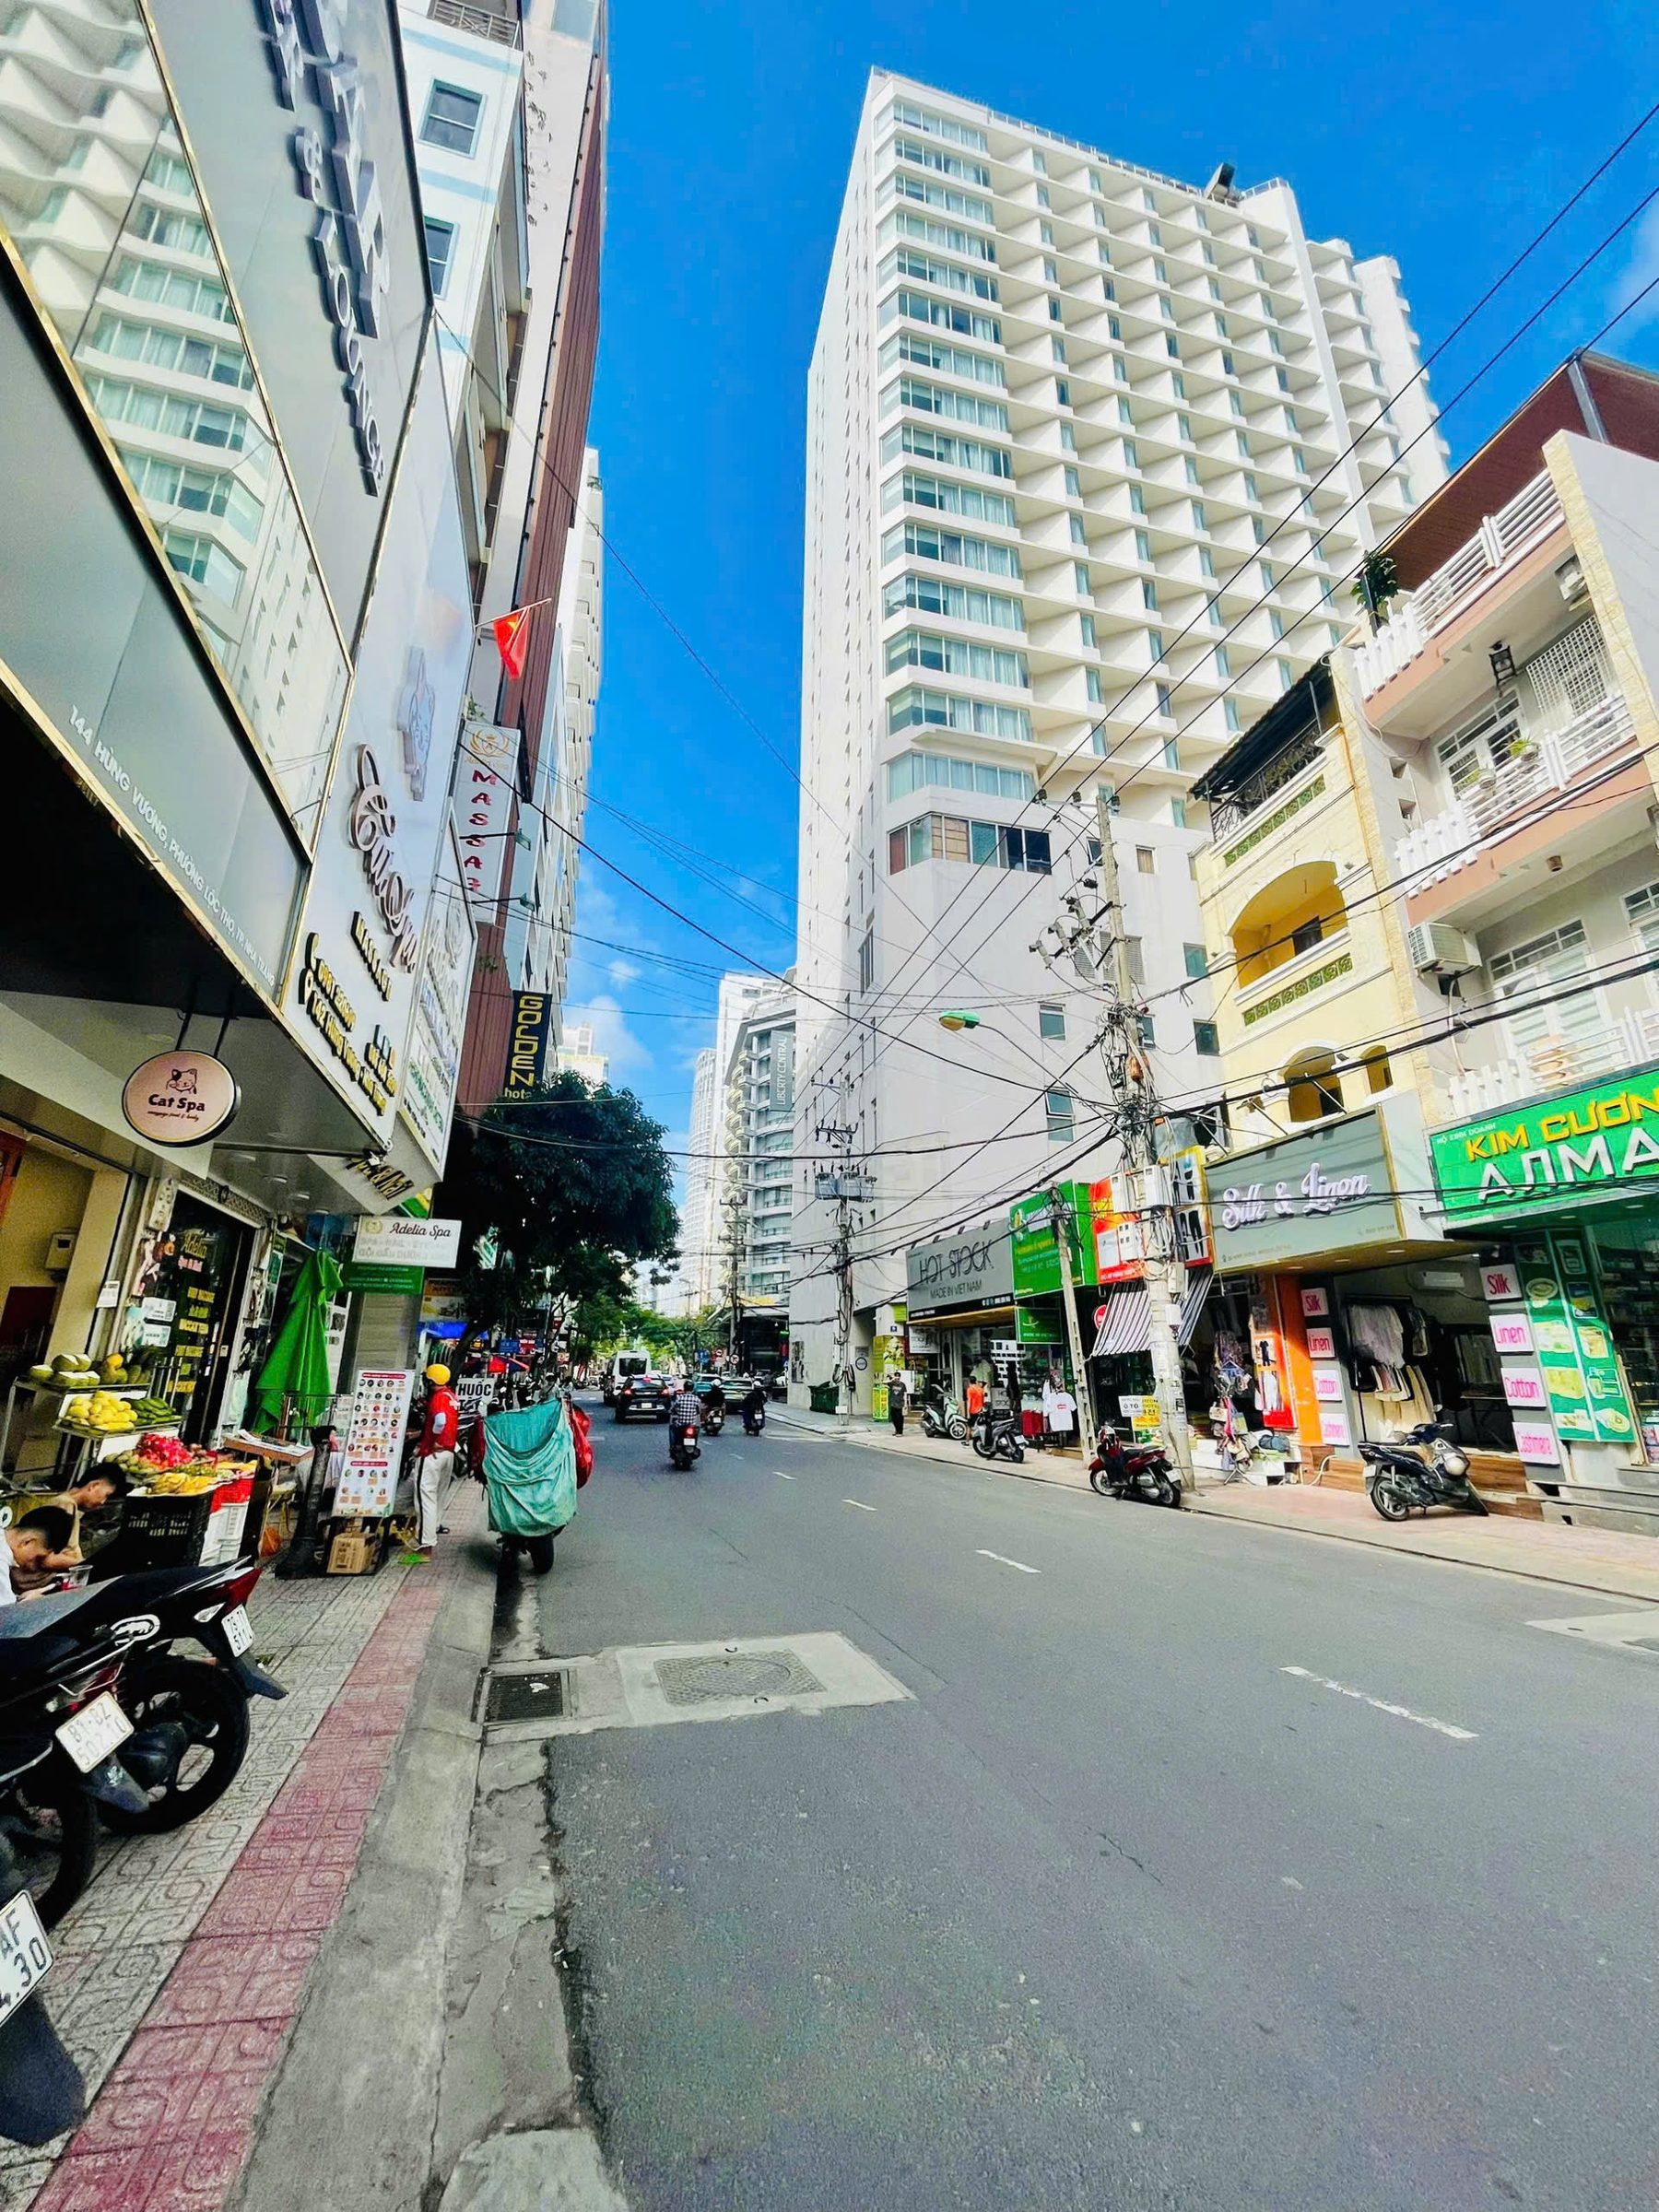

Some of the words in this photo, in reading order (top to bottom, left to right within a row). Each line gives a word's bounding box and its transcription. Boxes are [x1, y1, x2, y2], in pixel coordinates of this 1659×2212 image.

[315, 209, 386, 498] LOUNGE
[70, 705, 93, 746] 144
[94, 740, 132, 791] HÙNG
[510, 995, 544, 1087] GOLDEN
[777, 1037, 788, 1073] CENTRAL
[148, 1094, 174, 1108] Cat
[177, 1097, 205, 1112] Spa
[776, 1074, 786, 1106] LIBERTY
[1465, 1124, 1530, 1162] KIM
[1222, 1182, 1269, 1230] Silk
[1274, 1181, 1295, 1218] &
[390, 1221, 428, 1237] Adelia
[429, 1225, 452, 1241] Spa
[919, 1253, 943, 1285] HOT
[948, 1239, 994, 1278] STOCK
[1487, 1273, 1512, 1295] Silk
[1305, 1295, 1322, 1312] Silk
[1309, 1334, 1330, 1352] Linen
[1494, 1322, 1527, 1344] Linen
[1504, 1377, 1540, 1398] Cotton
